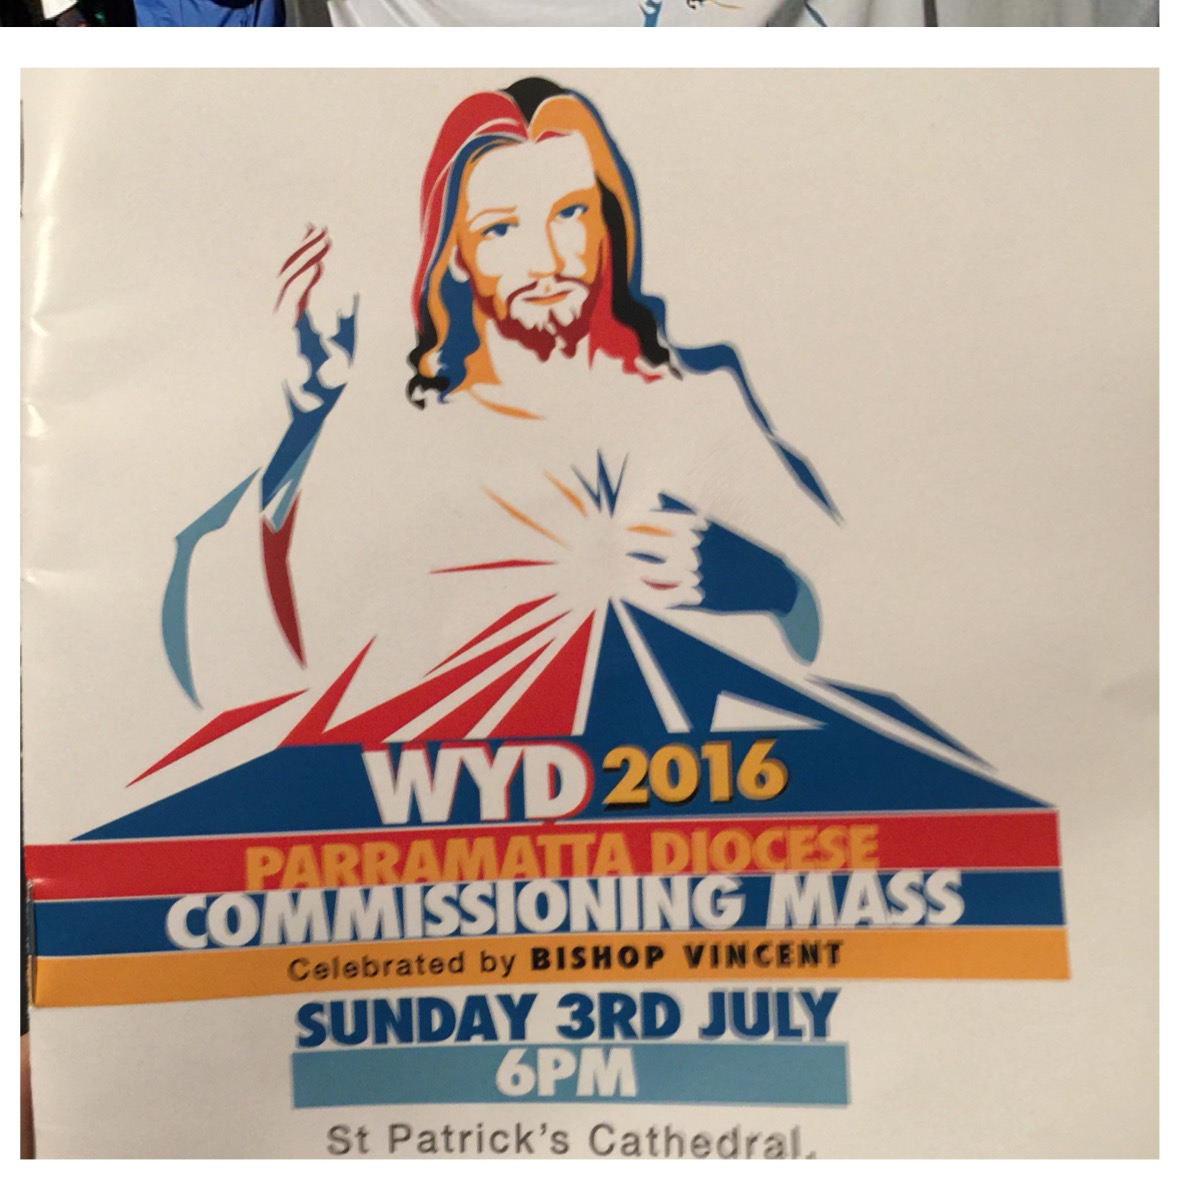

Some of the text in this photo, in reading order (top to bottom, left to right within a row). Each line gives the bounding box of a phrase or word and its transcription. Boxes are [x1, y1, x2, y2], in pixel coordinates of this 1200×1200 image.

[362, 738, 789, 826] WYD 2016
[244, 822, 882, 892] PARRAMATTA DIOCESE
[164, 868, 968, 950] COMMISSIONING MASS
[287, 938, 846, 982] Celebrated by BISHOP VINCENT
[293, 987, 843, 1049] SUNDAY 3RD JULY
[494, 1046, 639, 1098] 6PM
[325, 1122, 371, 1157] St
[386, 1120, 571, 1157] Patrick's
